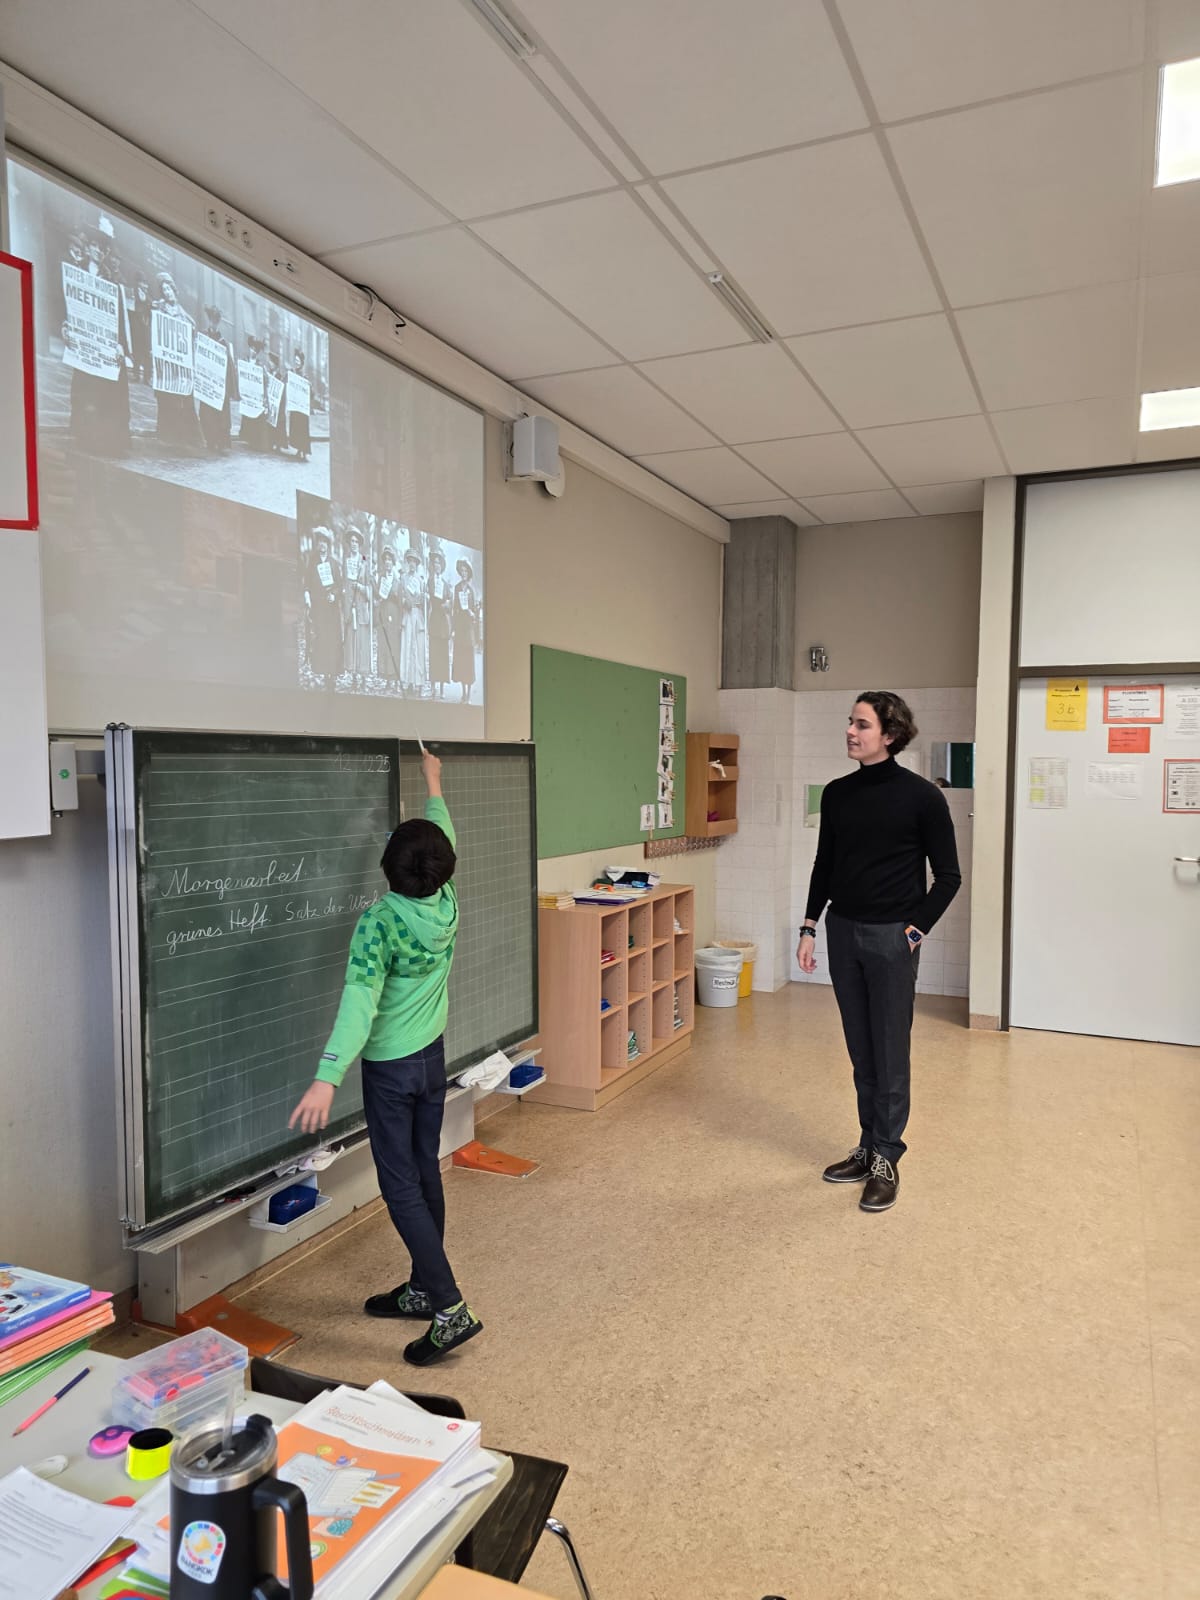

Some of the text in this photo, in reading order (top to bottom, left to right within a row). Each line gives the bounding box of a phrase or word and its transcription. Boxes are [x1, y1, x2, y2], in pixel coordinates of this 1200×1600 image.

[66, 283, 116, 315] MEETING
[157, 313, 188, 355] VOTES
[162, 350, 183, 362] FOR
[198, 345, 226, 367] MEETING
[155, 356, 192, 391] WOMEN
[285, 899, 319, 921] Satz
[323, 896, 345, 915] der
